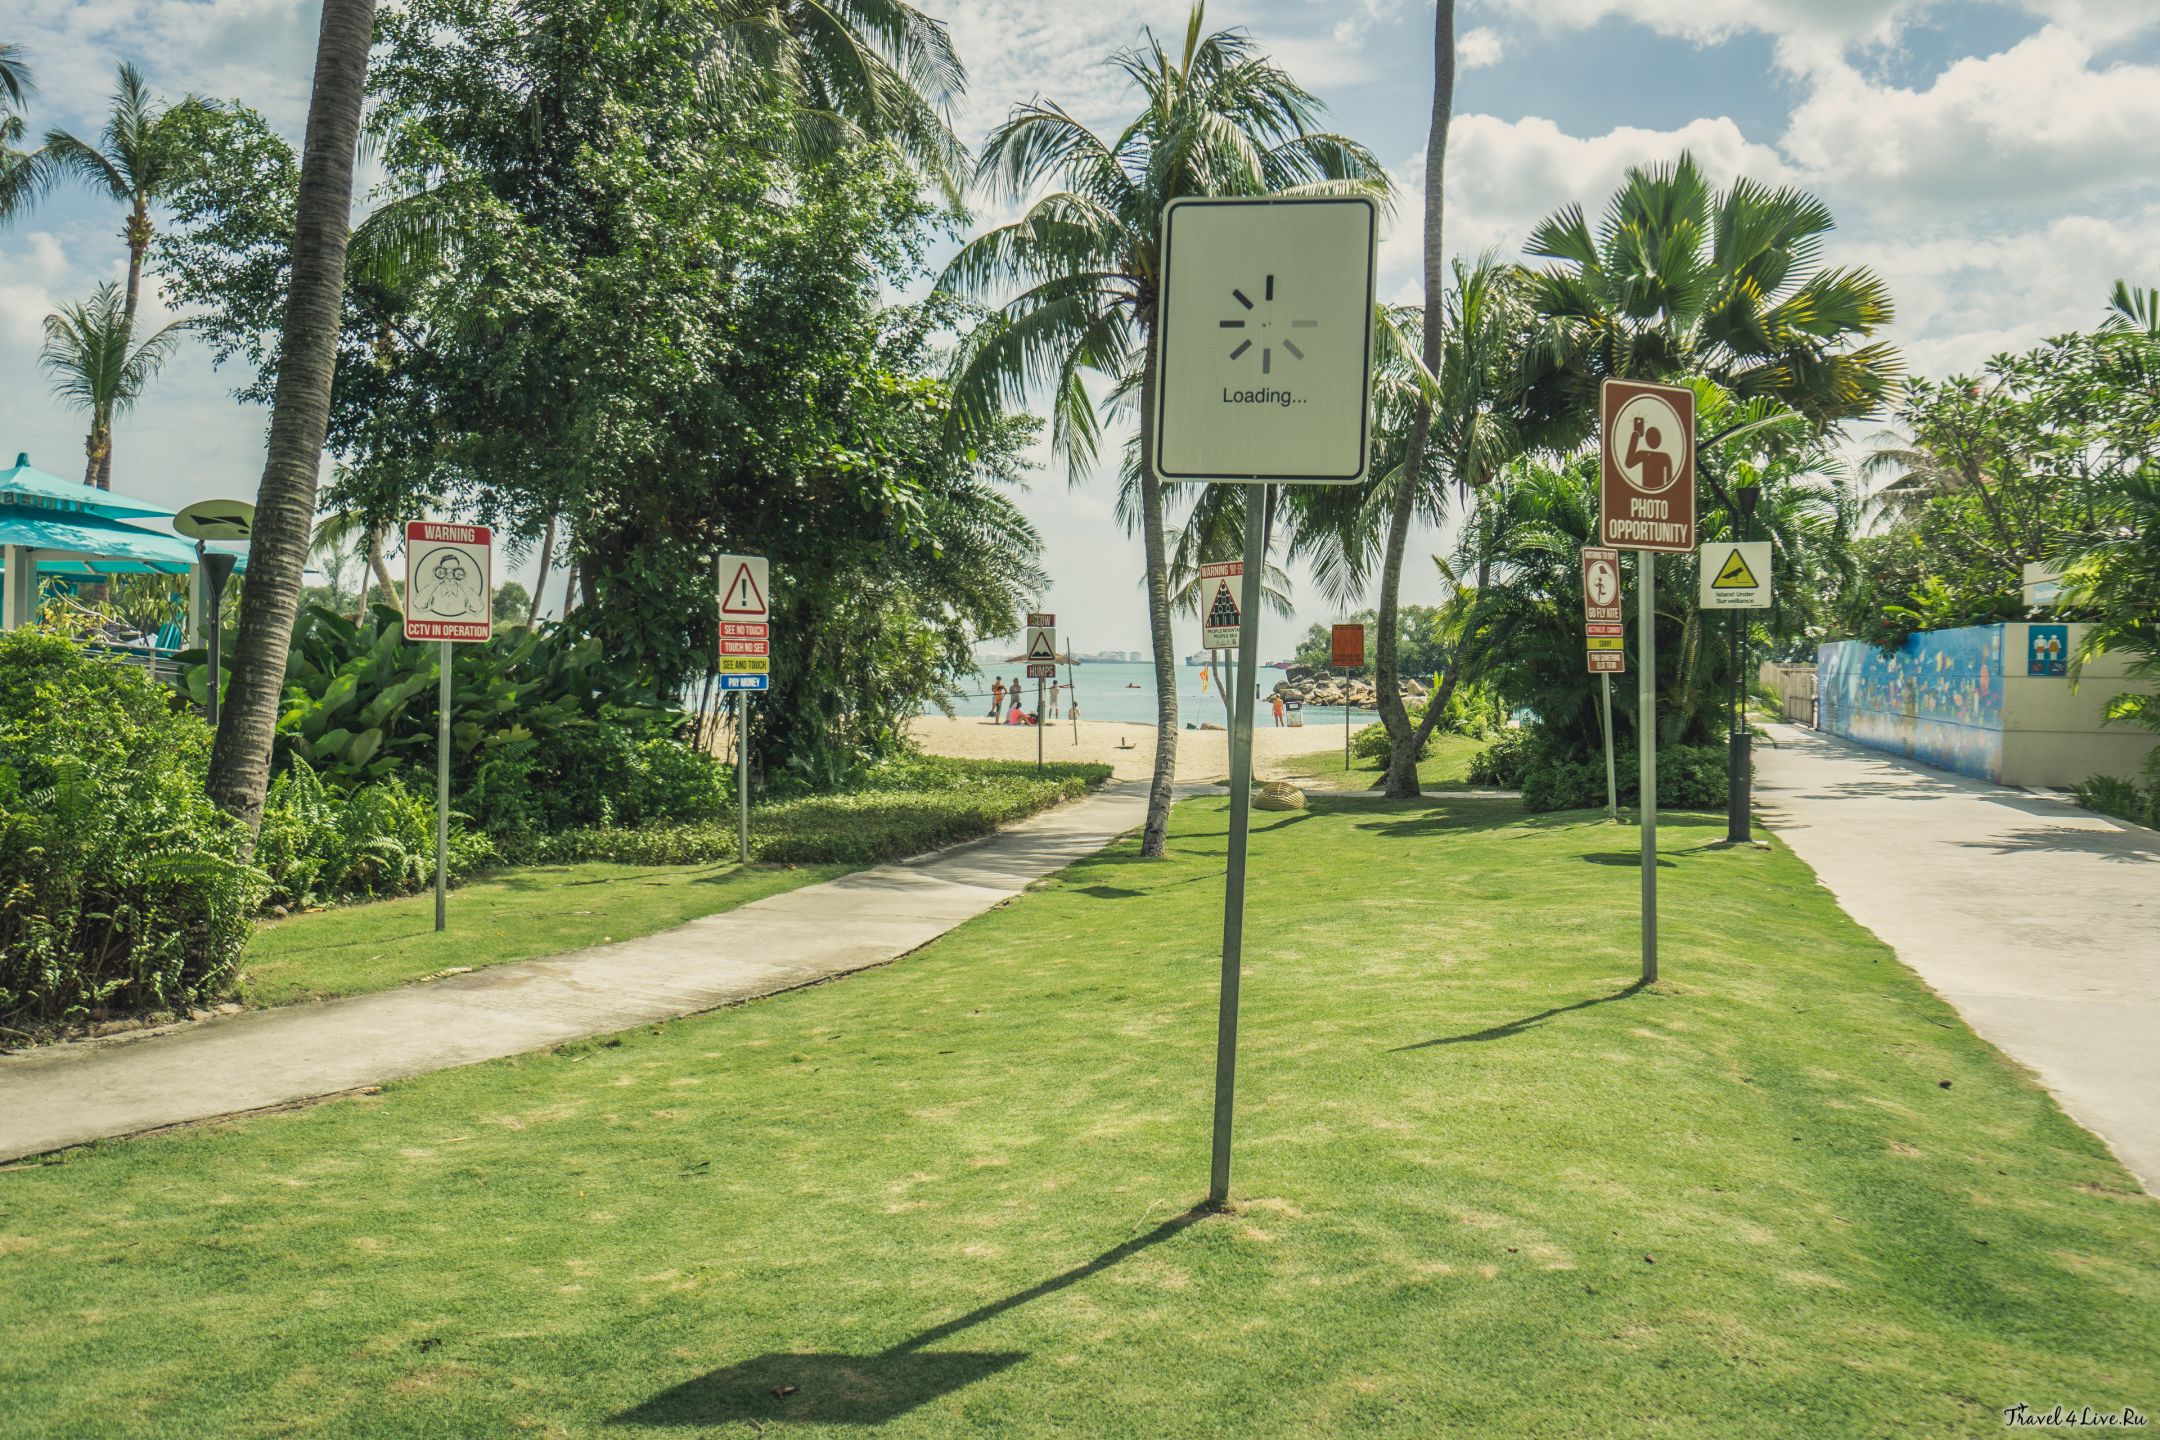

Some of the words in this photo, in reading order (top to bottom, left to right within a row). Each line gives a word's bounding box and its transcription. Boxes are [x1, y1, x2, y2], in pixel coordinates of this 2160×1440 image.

[1223, 387, 1307, 407] Loading...
[1630, 497, 1669, 520] PHOTO
[424, 524, 475, 543] WARNING
[1609, 518, 1688, 544] OPPORTUNITY
[1201, 564, 1229, 578] WARNING
[1596, 607, 1606, 618] FLY
[1606, 608, 1619, 619] KITE
[408, 623, 431, 636] CCTV
[432, 624, 441, 636] IN
[444, 625, 488, 637] OPERATION
[724, 624, 736, 635] SEE
[736, 625, 745, 635] NO
[745, 625, 765, 636] TOUCH
[725, 642, 744, 653] TOUCH
[744, 642, 753, 653] NO
[753, 642, 765, 653] SEE
[723, 660, 734, 670] SEE
[735, 660, 747, 670] AND
[748, 660, 767, 670] TOUCH
[1029, 665, 1054, 677] HUMPS
[728, 677, 740, 688] PAY
[740, 677, 761, 688] MONEY
